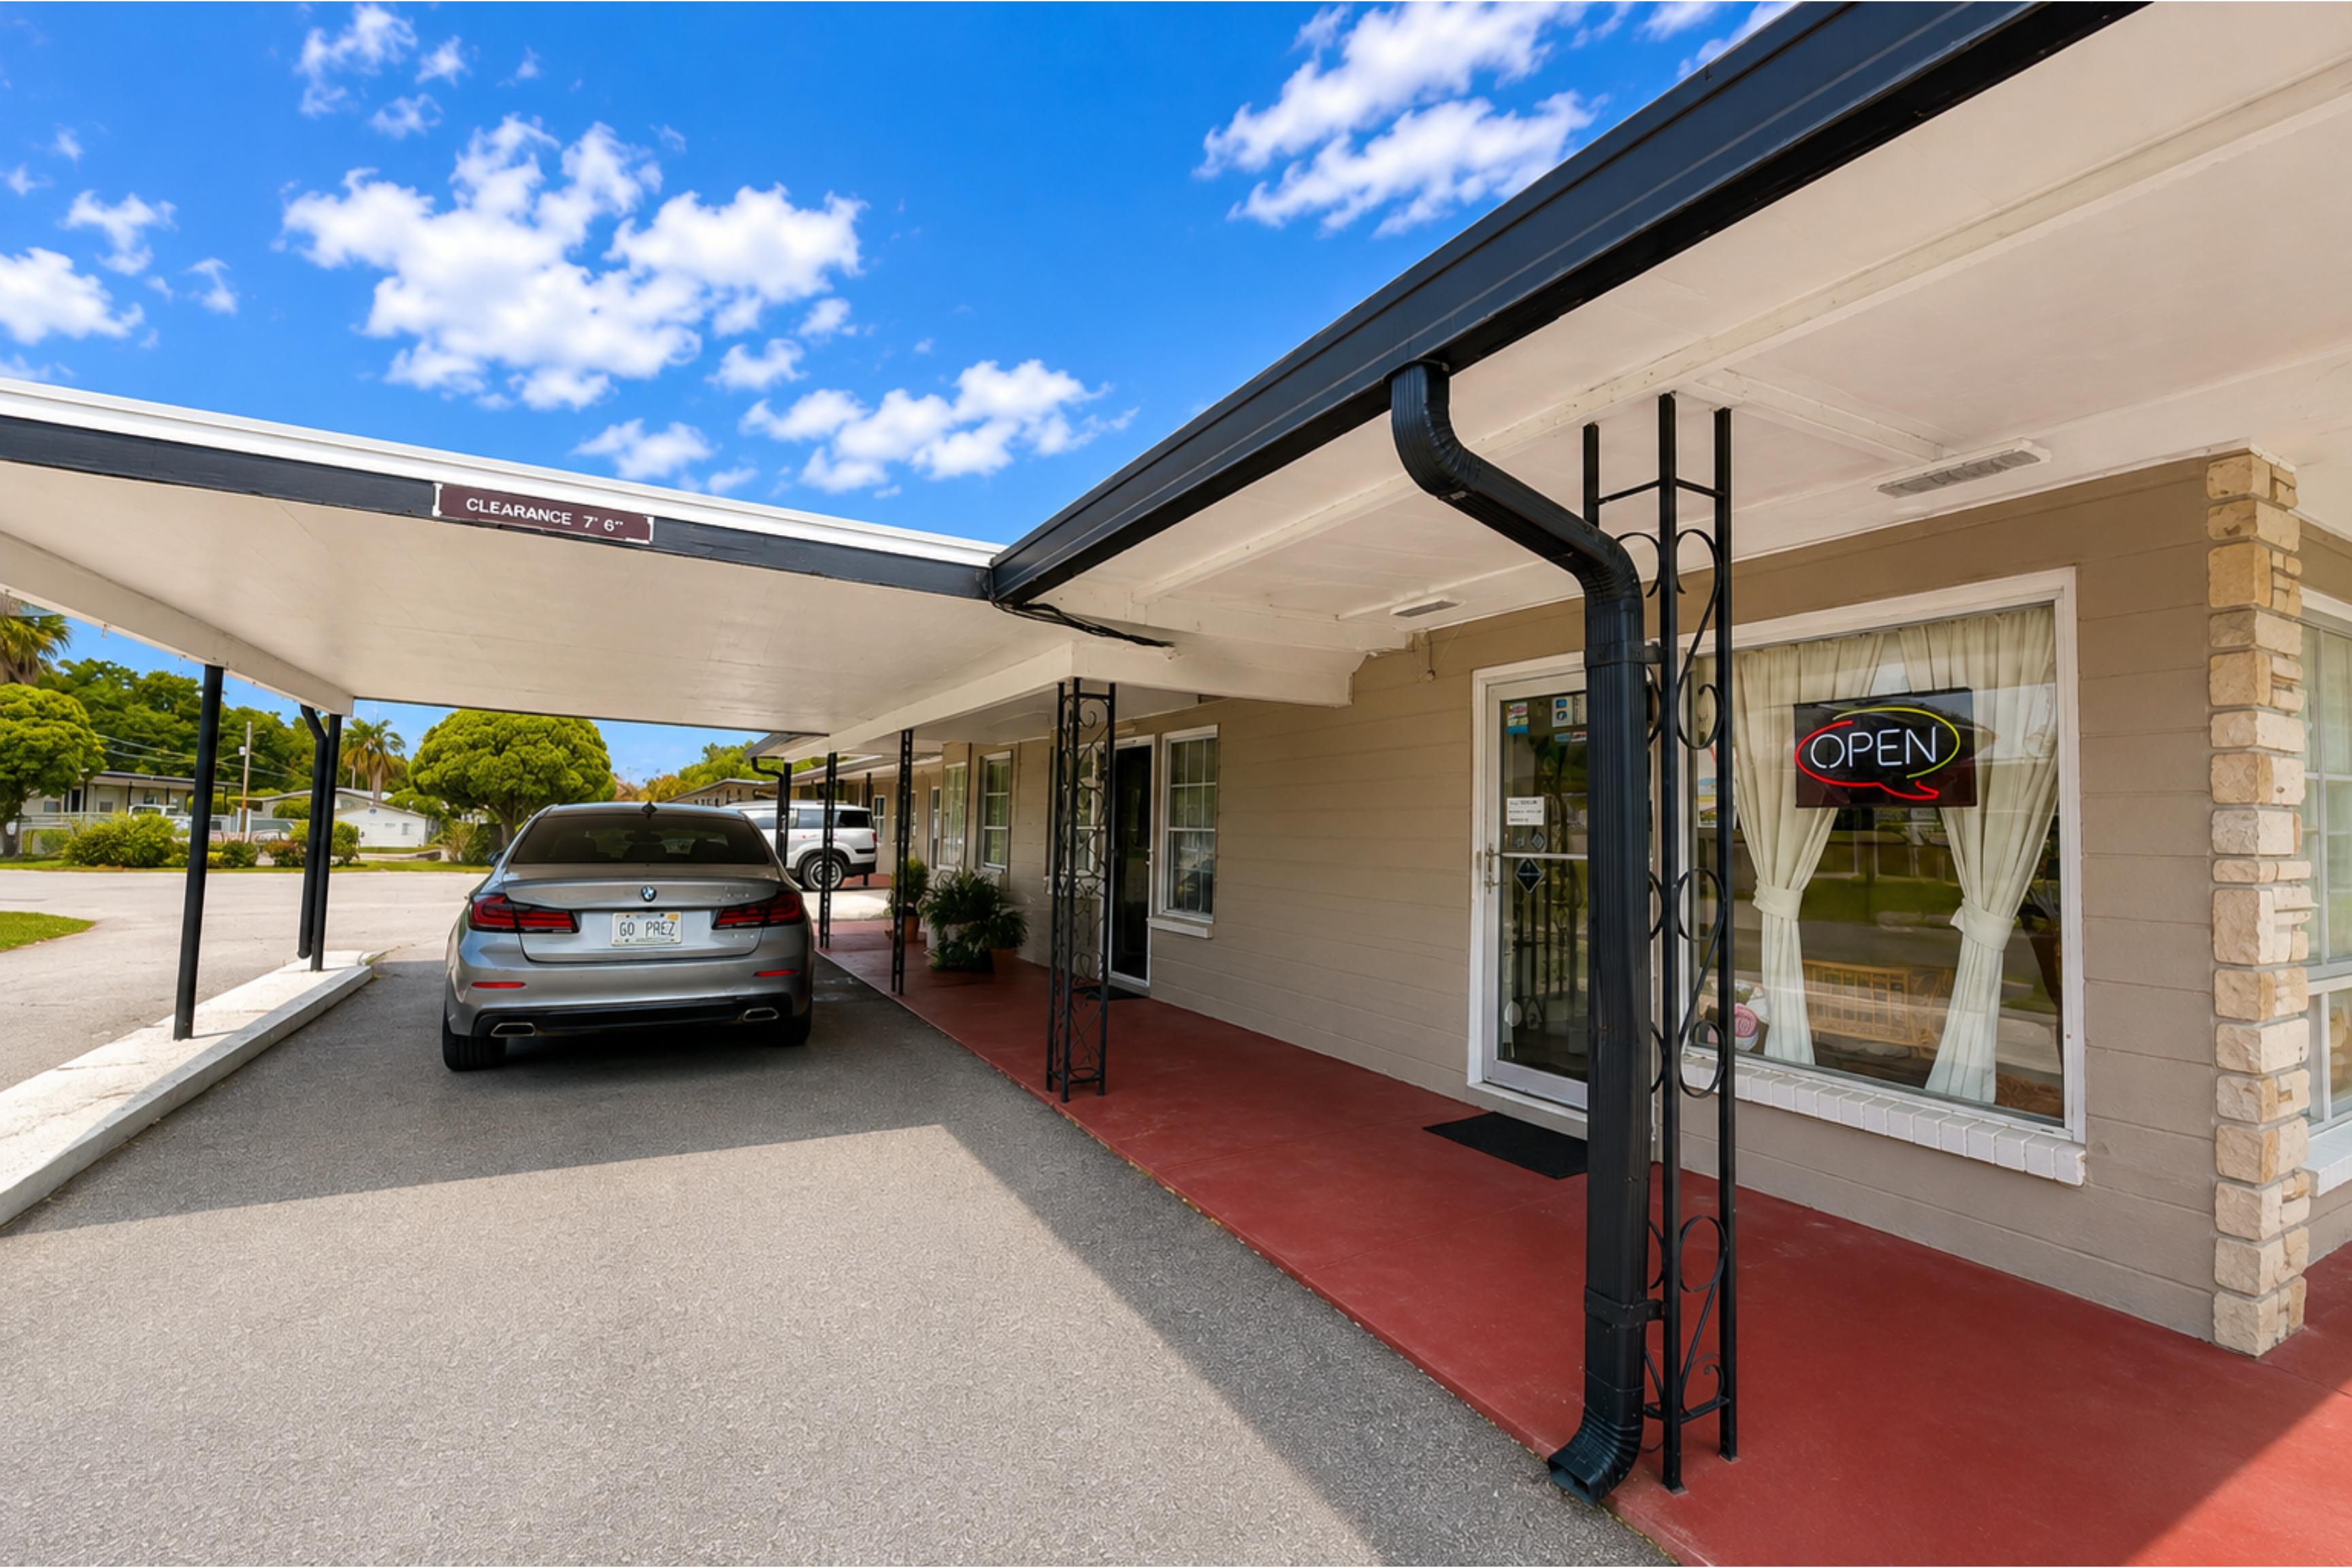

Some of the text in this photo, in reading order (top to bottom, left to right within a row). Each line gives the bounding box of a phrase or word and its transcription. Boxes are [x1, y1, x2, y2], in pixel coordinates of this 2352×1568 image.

[466, 497, 572, 525] CLEARANCE
[582, 514, 598, 529] 7'
[1810, 725, 1937, 769] OPEN
[619, 921, 636, 937] GO
